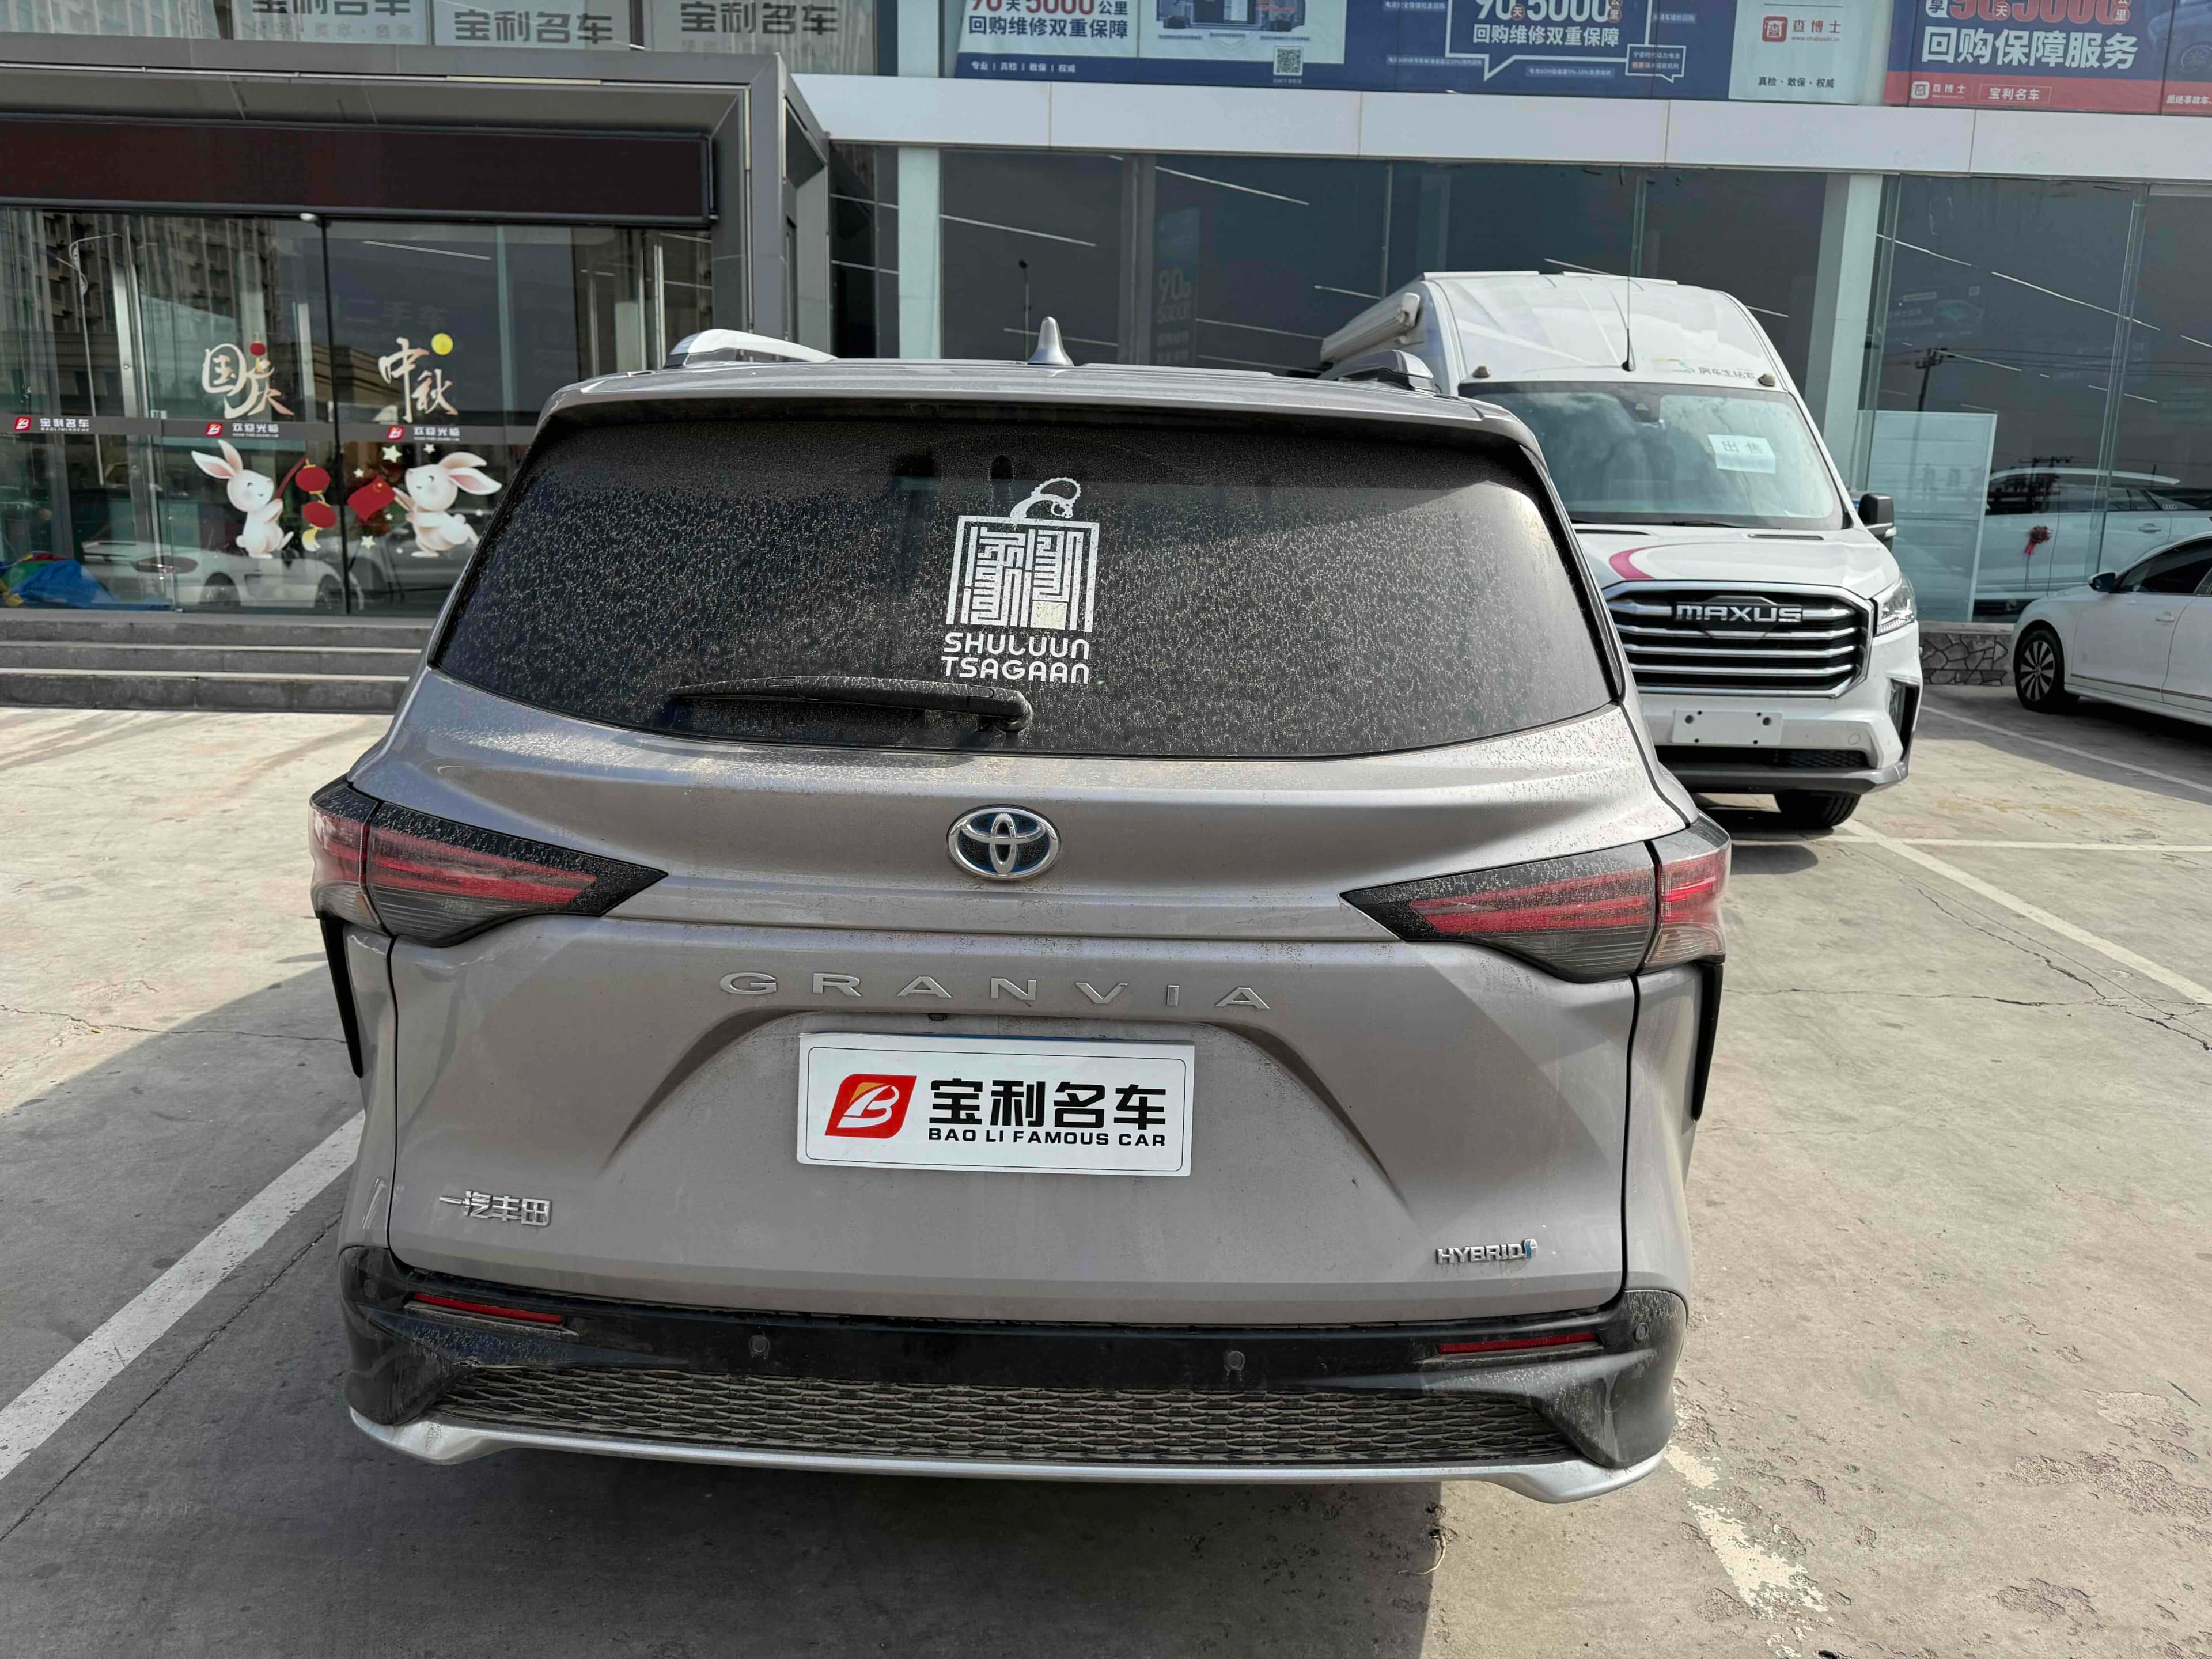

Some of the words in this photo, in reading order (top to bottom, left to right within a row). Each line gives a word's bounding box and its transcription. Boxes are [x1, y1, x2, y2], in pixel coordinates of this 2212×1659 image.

[454, 9, 612, 44] 宝利名车
[681, 1, 838, 35] 宝利名车
[969, 15, 1128, 39] 回购维修双重保障
[1793, 20, 1841, 33] 查博士
[1473, 24, 1620, 47] 回购维修双重保障
[1922, 26, 2138, 69] 回购保障服务
[1988, 87, 2040, 101] 宝利名车
[202, 343, 295, 419] 国庆
[378, 337, 459, 423] 中秋
[40, 418, 89, 427] 宝利名车
[232, 423, 279, 433] 欢迎光临
[1676, 604, 1802, 623] MAXUS
[944, 632, 1090, 660] SHULUUN
[941, 656, 1089, 684] TSAGAAN
[719, 972, 1270, 1010] GRANVIA
[929, 1078, 1166, 1130] 宝利名车
[929, 1128, 976, 1141] BAO
[986, 1130, 1003, 1142] LI
[1013, 1131, 1109, 1145] FAMOUS
[1119, 1134, 1165, 1146] CAR
[439, 1189, 551, 1226] 一汽丰田
[1436, 1243, 1524, 1264] HYBRID
